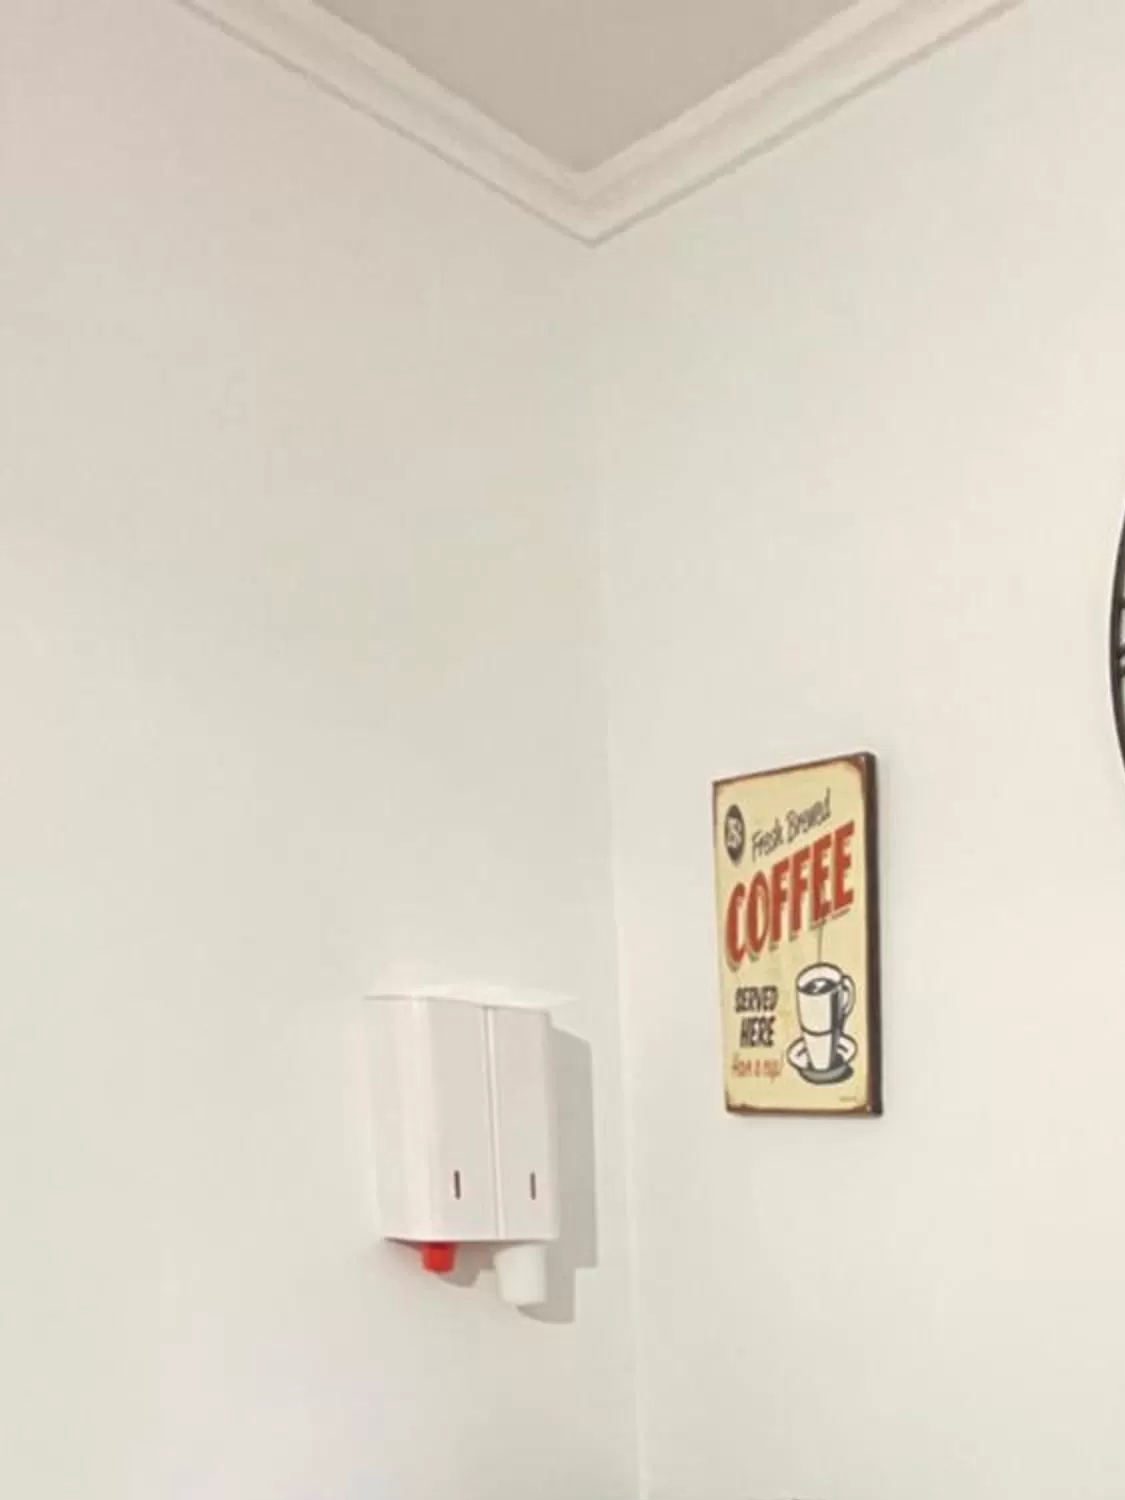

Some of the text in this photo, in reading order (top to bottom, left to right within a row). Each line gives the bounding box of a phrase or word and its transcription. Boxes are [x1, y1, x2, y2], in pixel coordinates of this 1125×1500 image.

[751, 815, 784, 863] Fresh
[785, 786, 831, 844] Brewed
[726, 819, 856, 970] COFFEE
[735, 985, 778, 1013] SERVED
[740, 1015, 776, 1048] HERE
